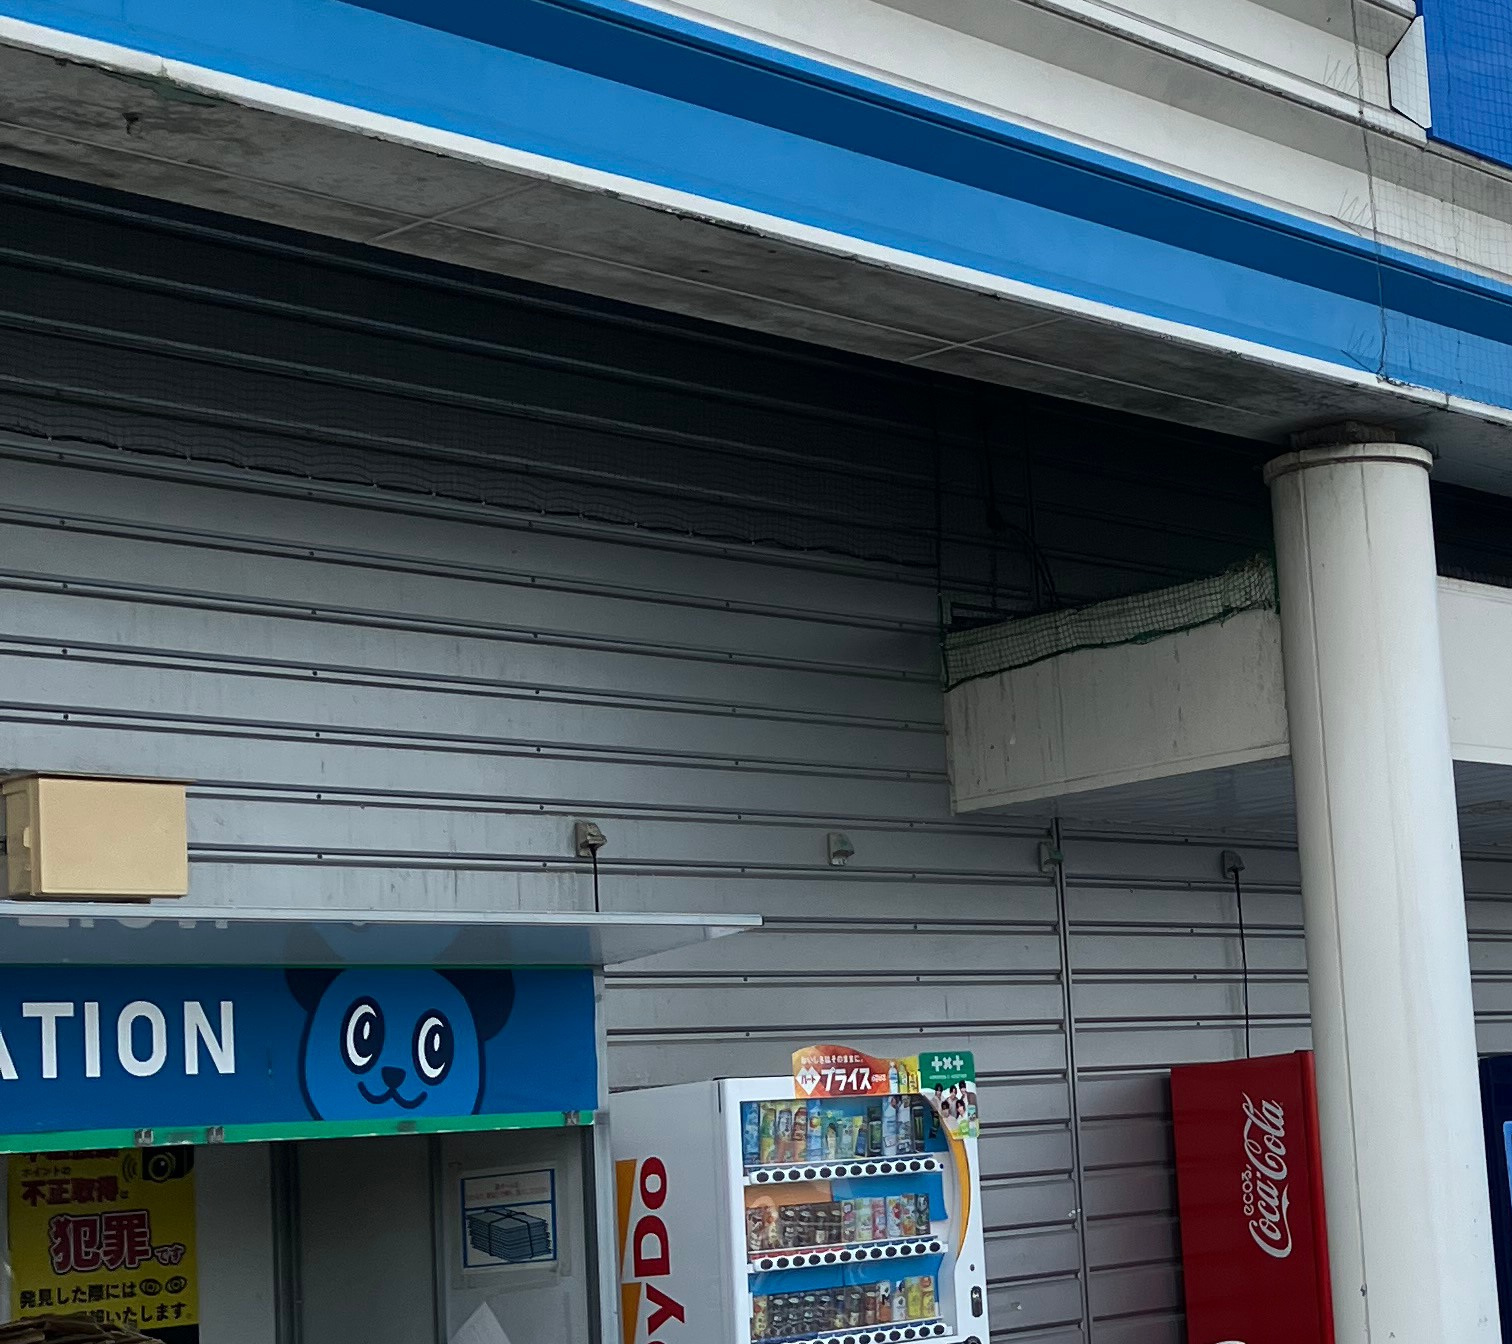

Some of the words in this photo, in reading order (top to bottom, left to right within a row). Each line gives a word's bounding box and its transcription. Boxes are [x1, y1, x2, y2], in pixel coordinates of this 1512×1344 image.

[0, 1000, 236, 1080] TION
[821, 1066, 873, 1092] プライス
[1242, 1091, 1292, 1259] Coca-Cola
[49, 1209, 186, 1275] 犯罪です
